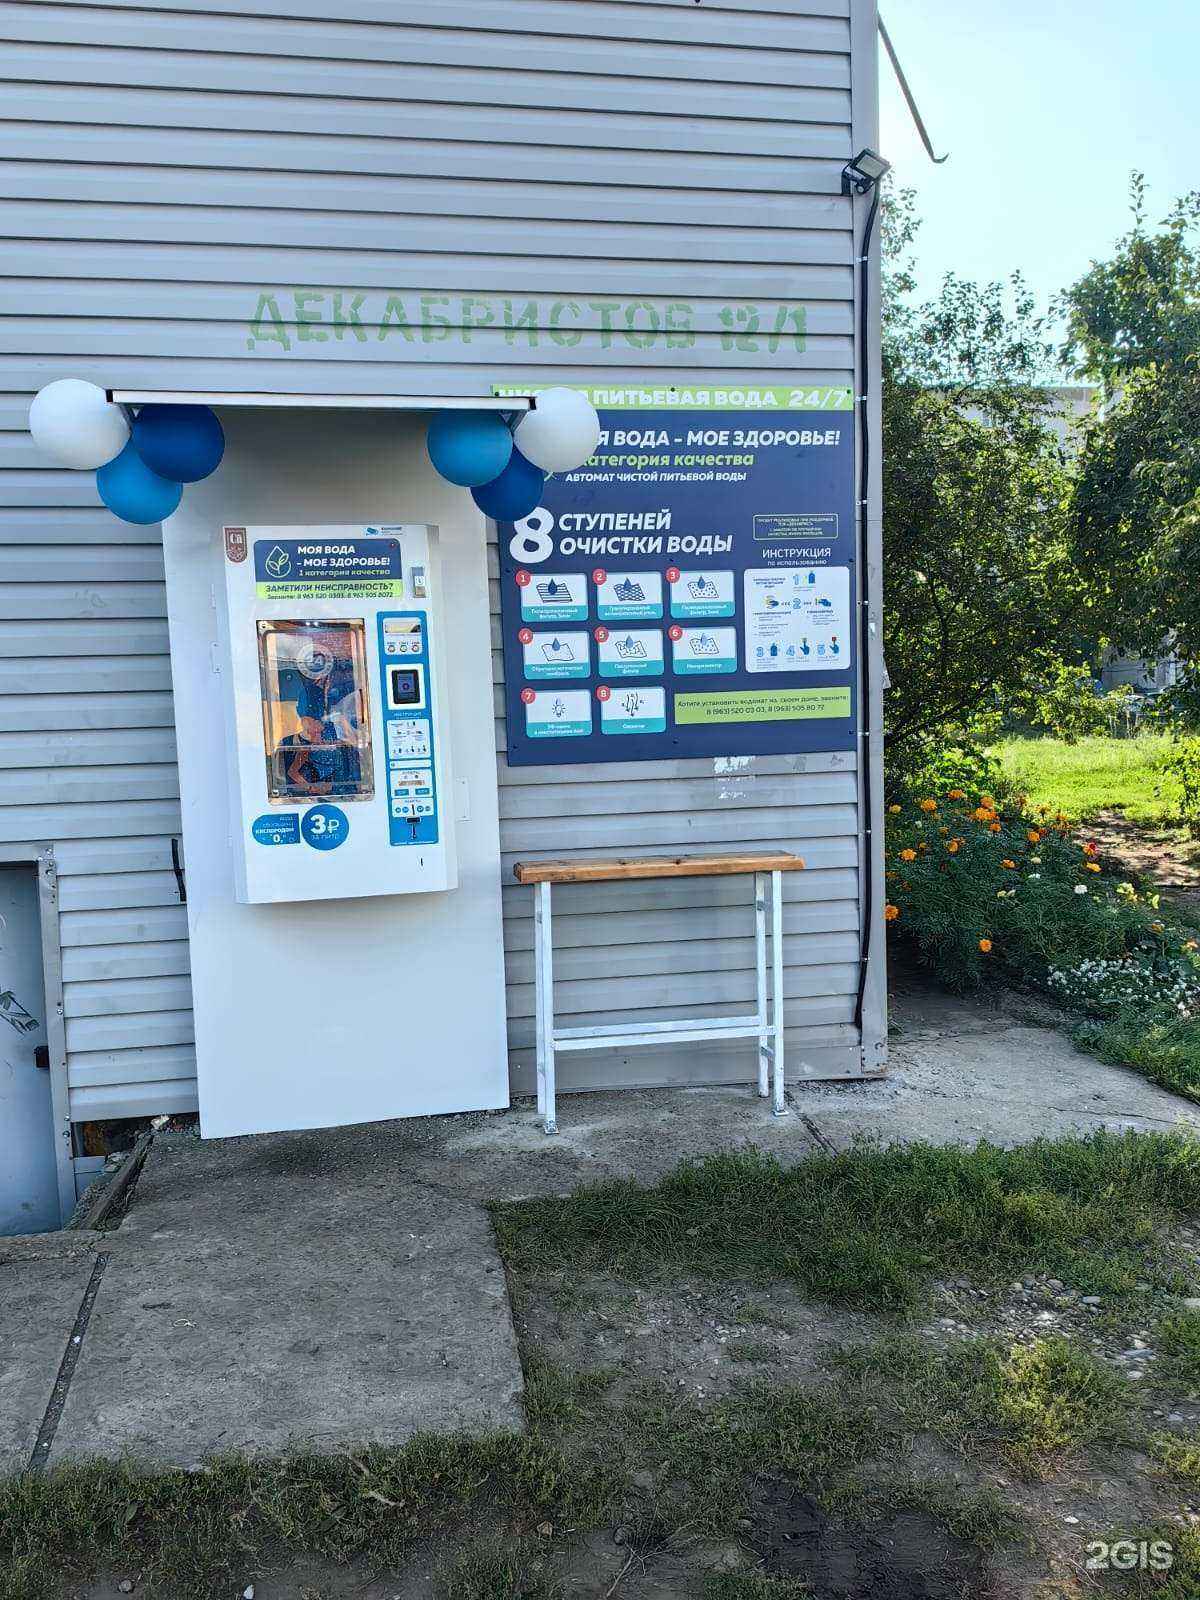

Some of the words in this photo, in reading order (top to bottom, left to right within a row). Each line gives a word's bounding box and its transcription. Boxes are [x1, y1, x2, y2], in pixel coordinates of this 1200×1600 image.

[247, 291, 695, 351] ДЕКАБРИСТОВ
[719, 304, 807, 353] 12/1
[594, 390, 713, 405] ПИТЬЕВАЯ
[715, 390, 778, 408] ВОДА
[788, 389, 847, 408] 24/7
[613, 430, 670, 448] ВОДА
[686, 430, 729, 446] МОЕ
[732, 430, 841, 448] ЗДОРОВЬЕ!
[674, 454, 755, 466] качества
[565, 473, 614, 482] АВТОМАТ
[616, 471, 658, 482] ЧИСТОЙ
[659, 471, 713, 482] ПИТЬЕВОЙ
[716, 472, 747, 482] ВОДЫ
[509, 506, 555, 564] 8
[559, 508, 672, 531] СТУПЕНЕЙ
[297, 545, 322, 554] МОЯ
[324, 545, 355, 555] ВОДА
[559, 536, 663, 555] ОЧИСТКИ
[666, 534, 733, 556] ВОДЫ
[762, 547, 831, 559] ИНСТРУКЦИЯ
[303, 558, 329, 567] МОЕ
[329, 557, 390, 567] ЗДОРОВЬЕ!
[305, 569, 350, 577] категория
[265, 584, 312, 592] ЗАМЕТИЛИ
[314, 582, 394, 591] НЕИСПРАВНОСТЬ?
